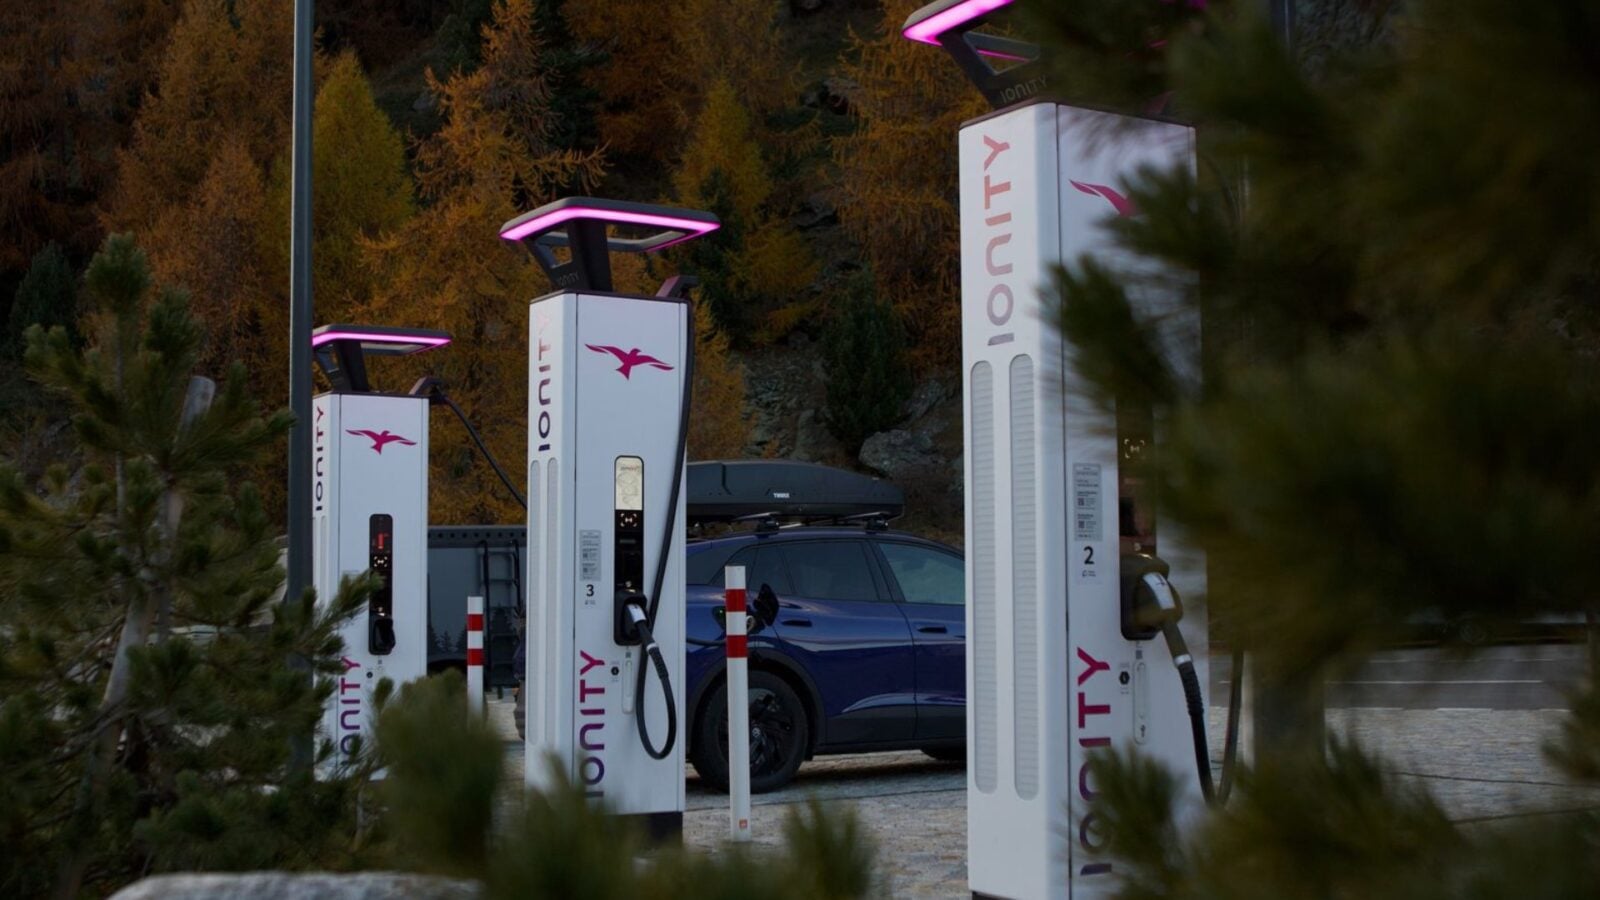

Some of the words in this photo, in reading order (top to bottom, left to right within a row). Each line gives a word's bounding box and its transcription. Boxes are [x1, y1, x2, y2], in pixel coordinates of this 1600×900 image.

[983, 134, 1014, 346] IONITY
[538, 309, 551, 451] IONITY
[316, 406, 324, 511] IONITY
[586, 584, 595, 597] 3
[1083, 545, 1096, 565] 2
[341, 656, 360, 765] ONITY
